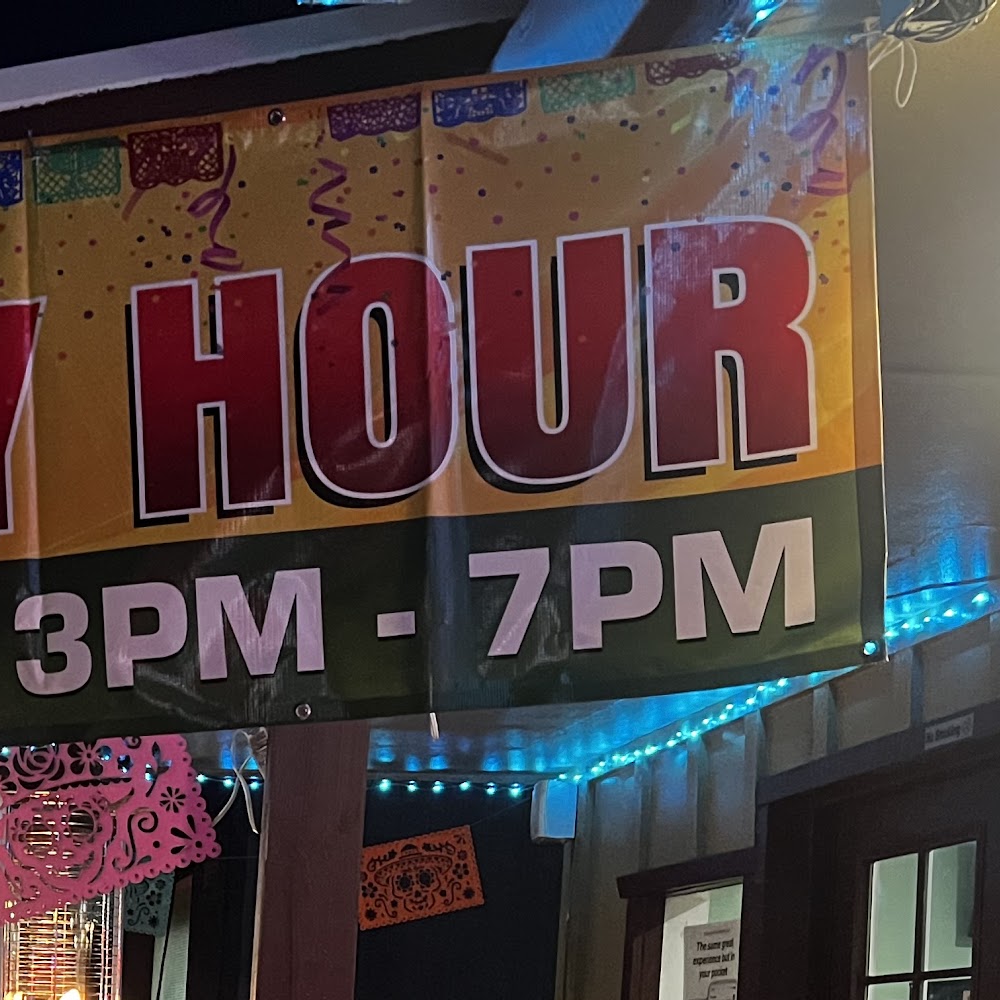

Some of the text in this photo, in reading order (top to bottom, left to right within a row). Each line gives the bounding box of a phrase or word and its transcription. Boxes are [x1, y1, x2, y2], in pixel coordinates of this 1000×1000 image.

[125, 214, 818, 529] HOUR
[13, 566, 326, 697] 3PM
[376, 610, 416, 638] -
[468, 516, 817, 659] 7PM
